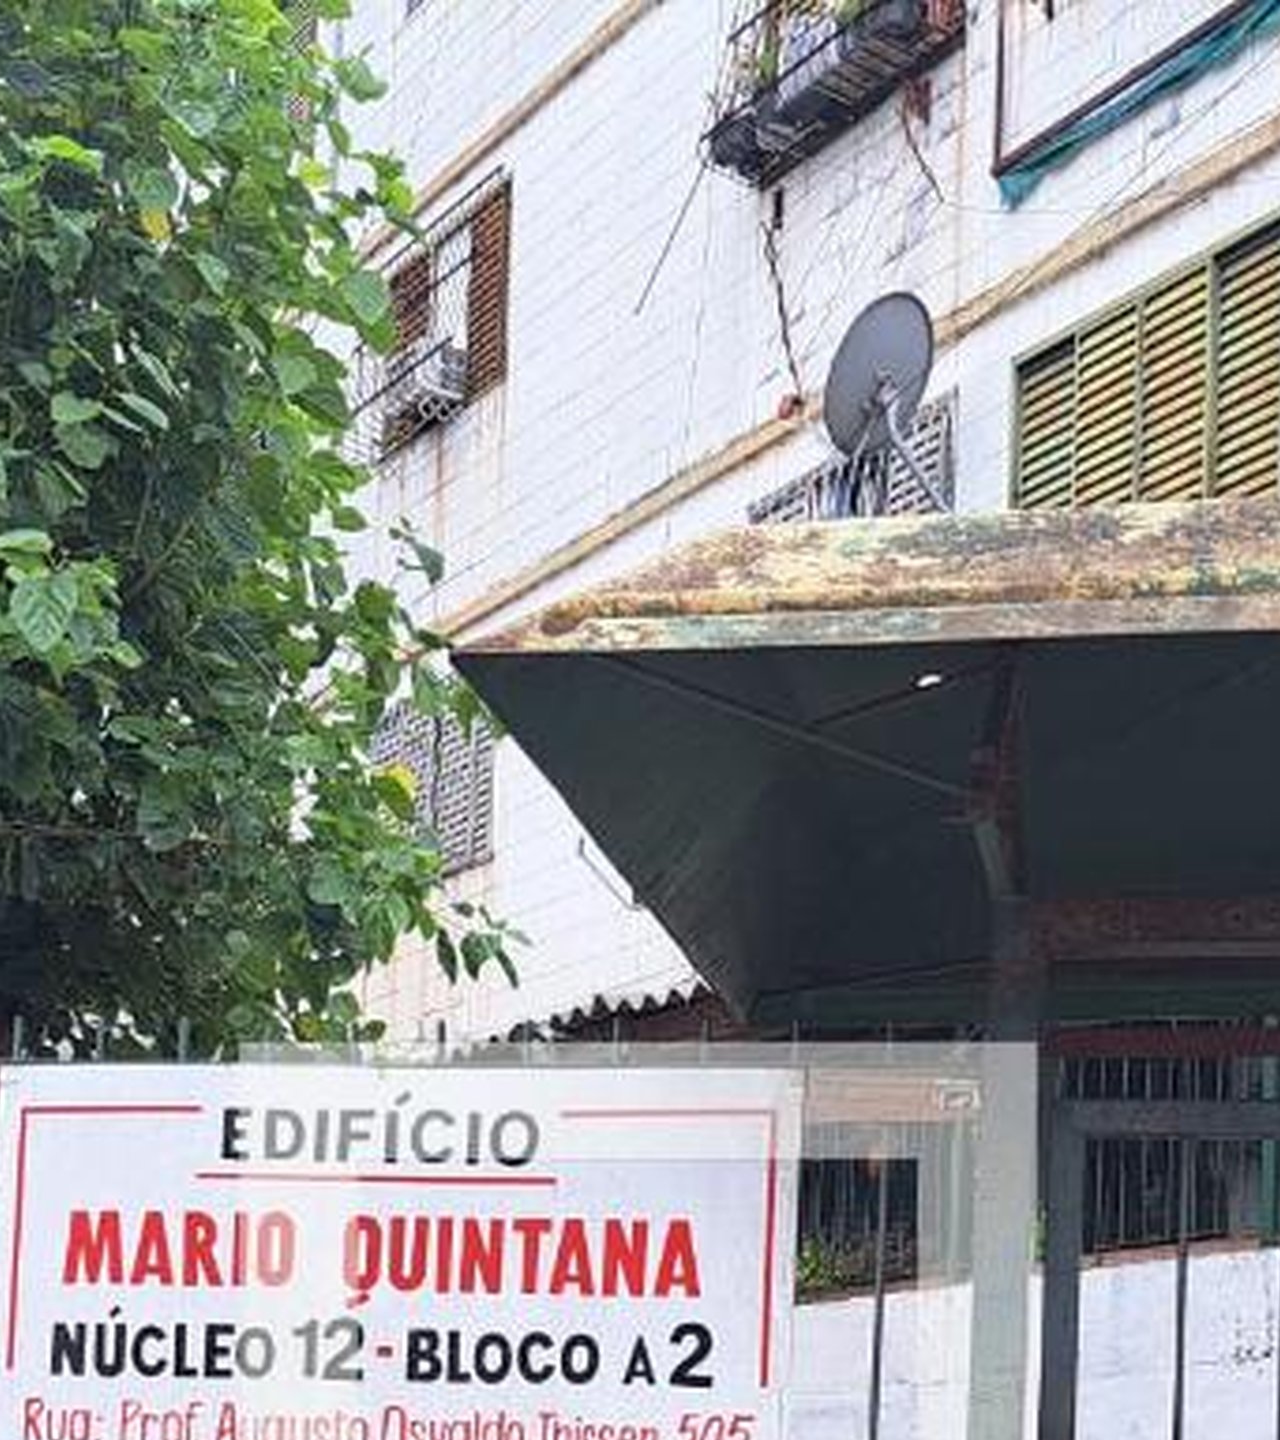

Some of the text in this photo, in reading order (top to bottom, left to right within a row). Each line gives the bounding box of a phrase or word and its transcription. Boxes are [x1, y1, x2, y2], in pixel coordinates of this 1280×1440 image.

[221, 1091, 540, 1168] EDIFÍCIO
[62, 1208, 702, 1308] MARIO QUINTANA
[50, 1306, 276, 1380] NÚCLEO
[293, 1316, 365, 1381] 12
[405, 1328, 600, 1386] BLOCO
